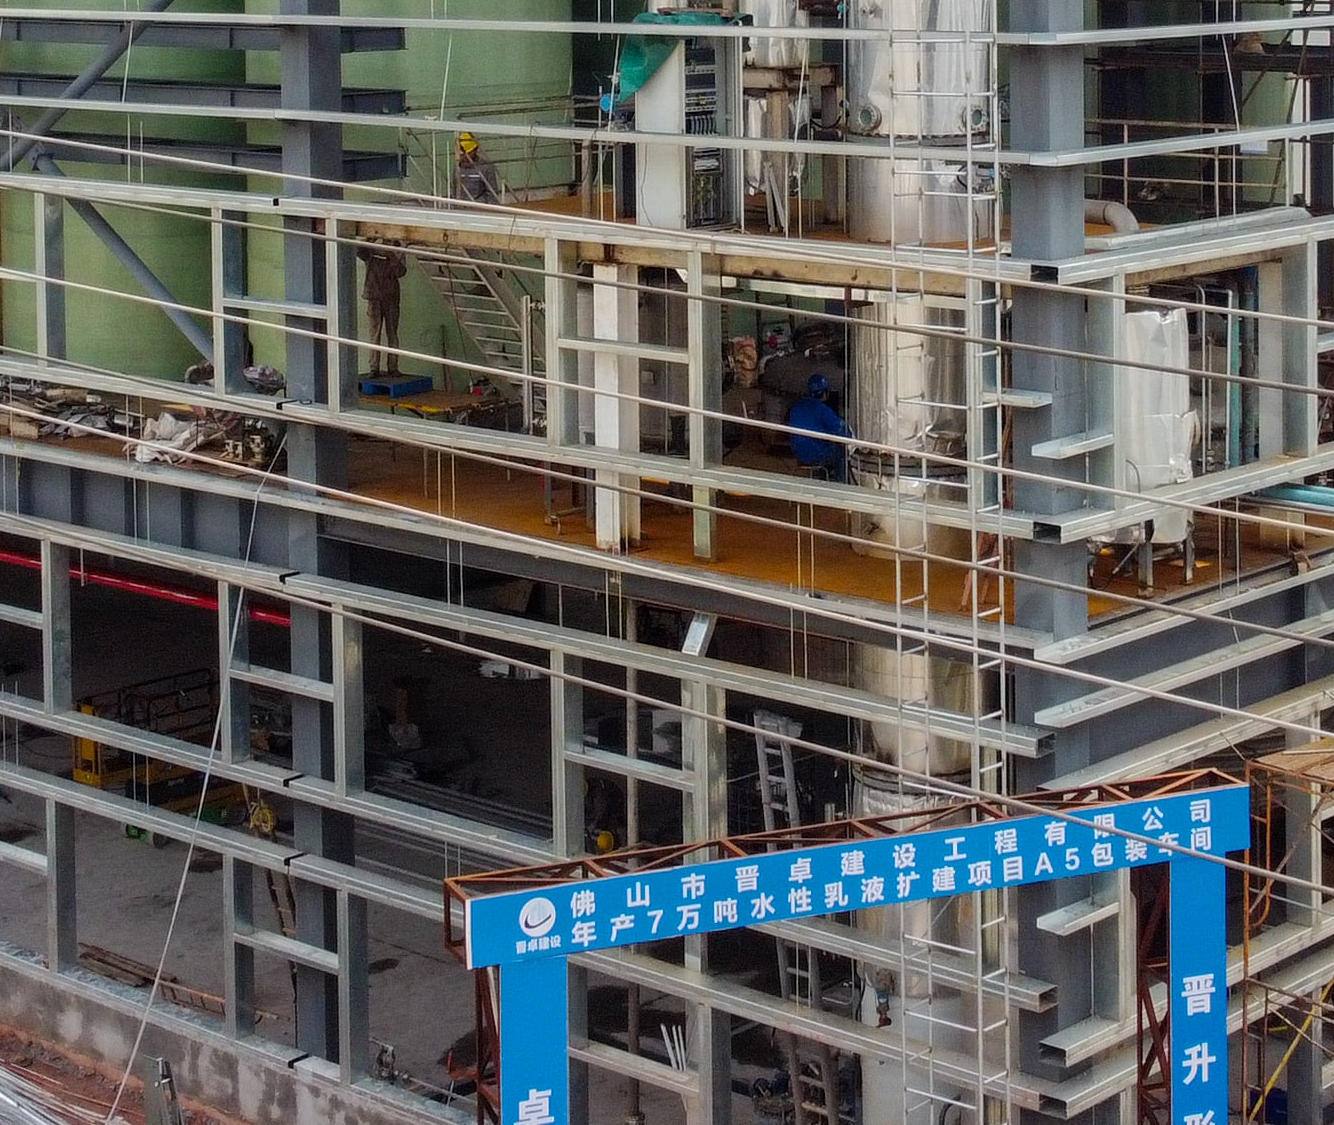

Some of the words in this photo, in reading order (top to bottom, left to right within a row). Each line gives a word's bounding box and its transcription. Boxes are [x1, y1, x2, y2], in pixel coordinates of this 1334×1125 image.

[570, 798, 1212, 917] 佛山市晋卓建设工程有限公司
[570, 827, 1213, 948] 年产7万吨水性乳液扩建项目A5包装车间
